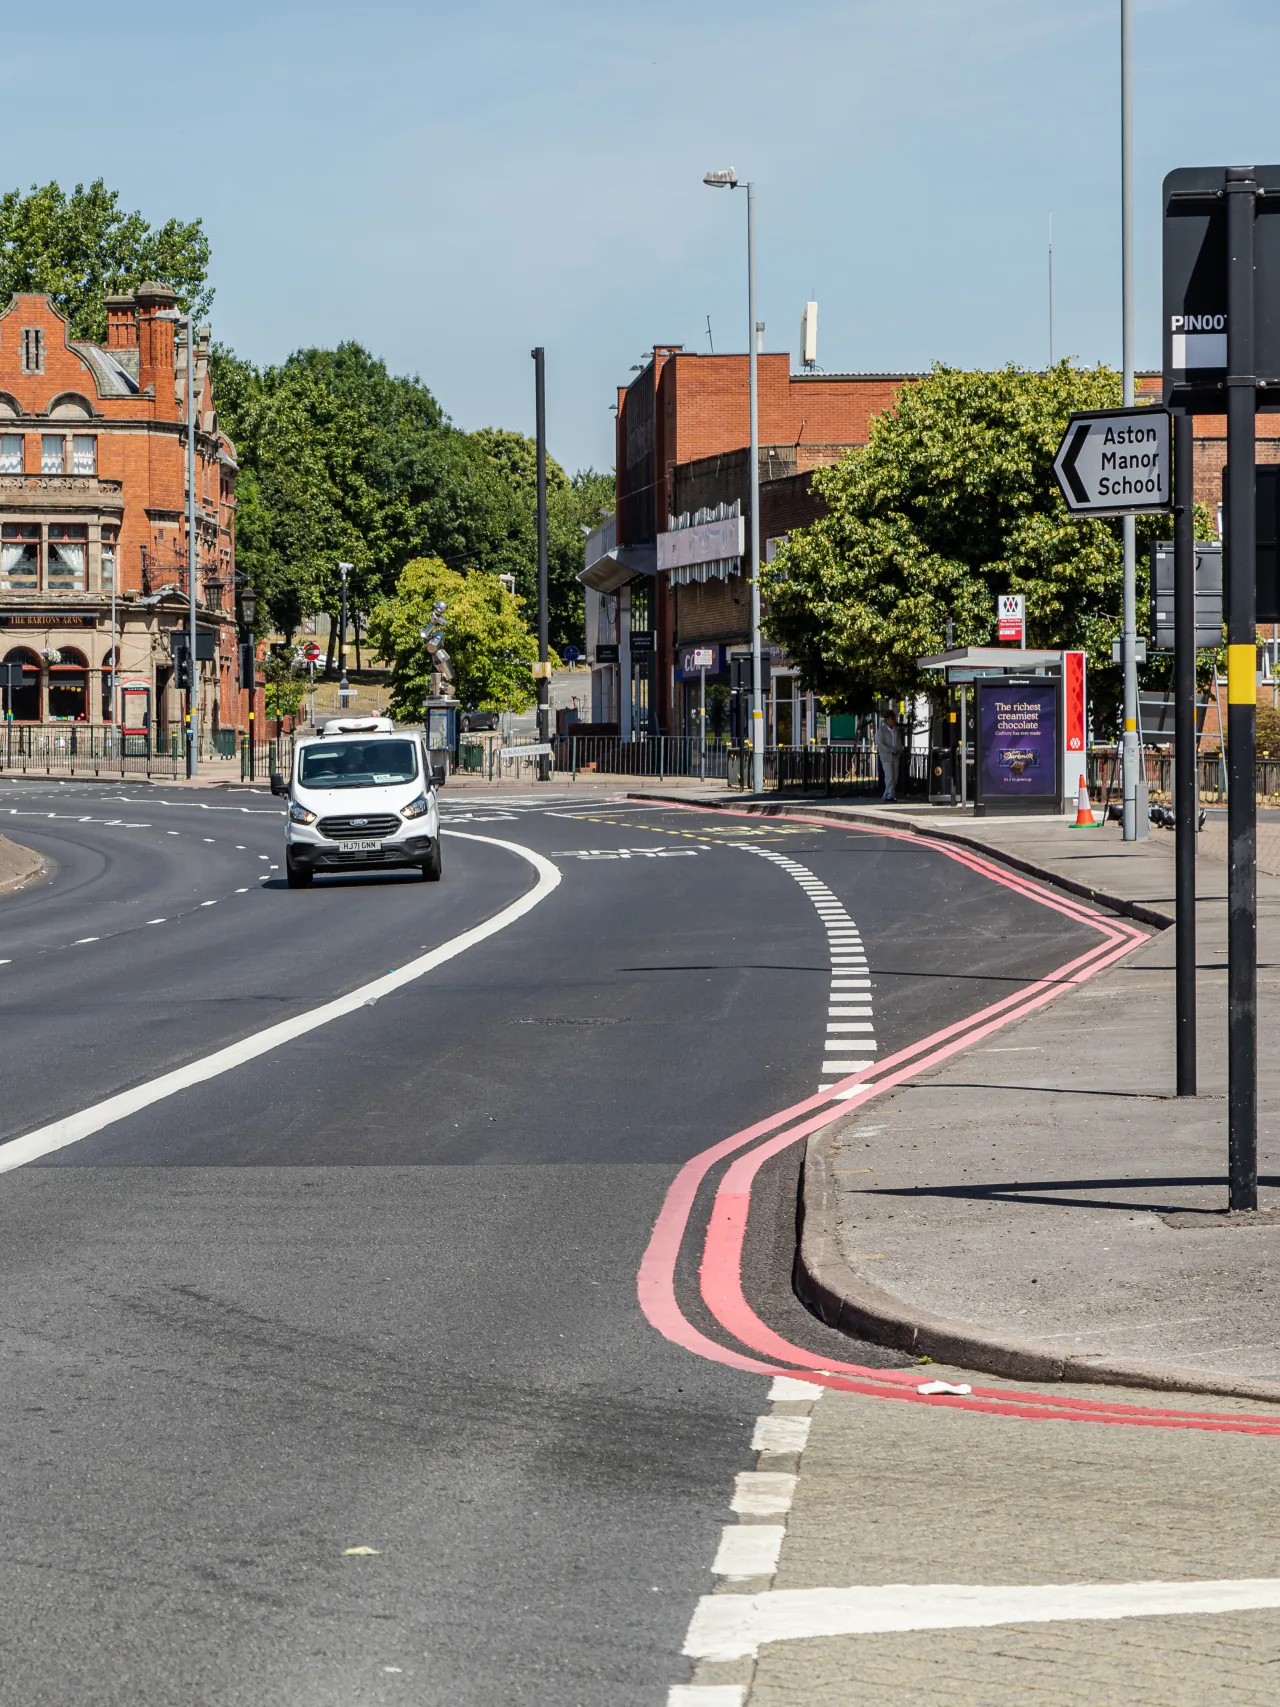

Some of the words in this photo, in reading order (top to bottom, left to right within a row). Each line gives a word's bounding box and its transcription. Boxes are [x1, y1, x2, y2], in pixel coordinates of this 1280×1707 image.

[1171, 314, 1227, 331] PIN00
[1103, 425, 1157, 445] Aston
[1101, 452, 1160, 471] Manor
[1098, 474, 1162, 496] School
[11, 616, 25, 624] THE
[995, 702, 1011, 711] The
[1013, 702, 1041, 711] richest
[997, 712, 1038, 720] creamiest
[997, 721, 1038, 729] chocolate
